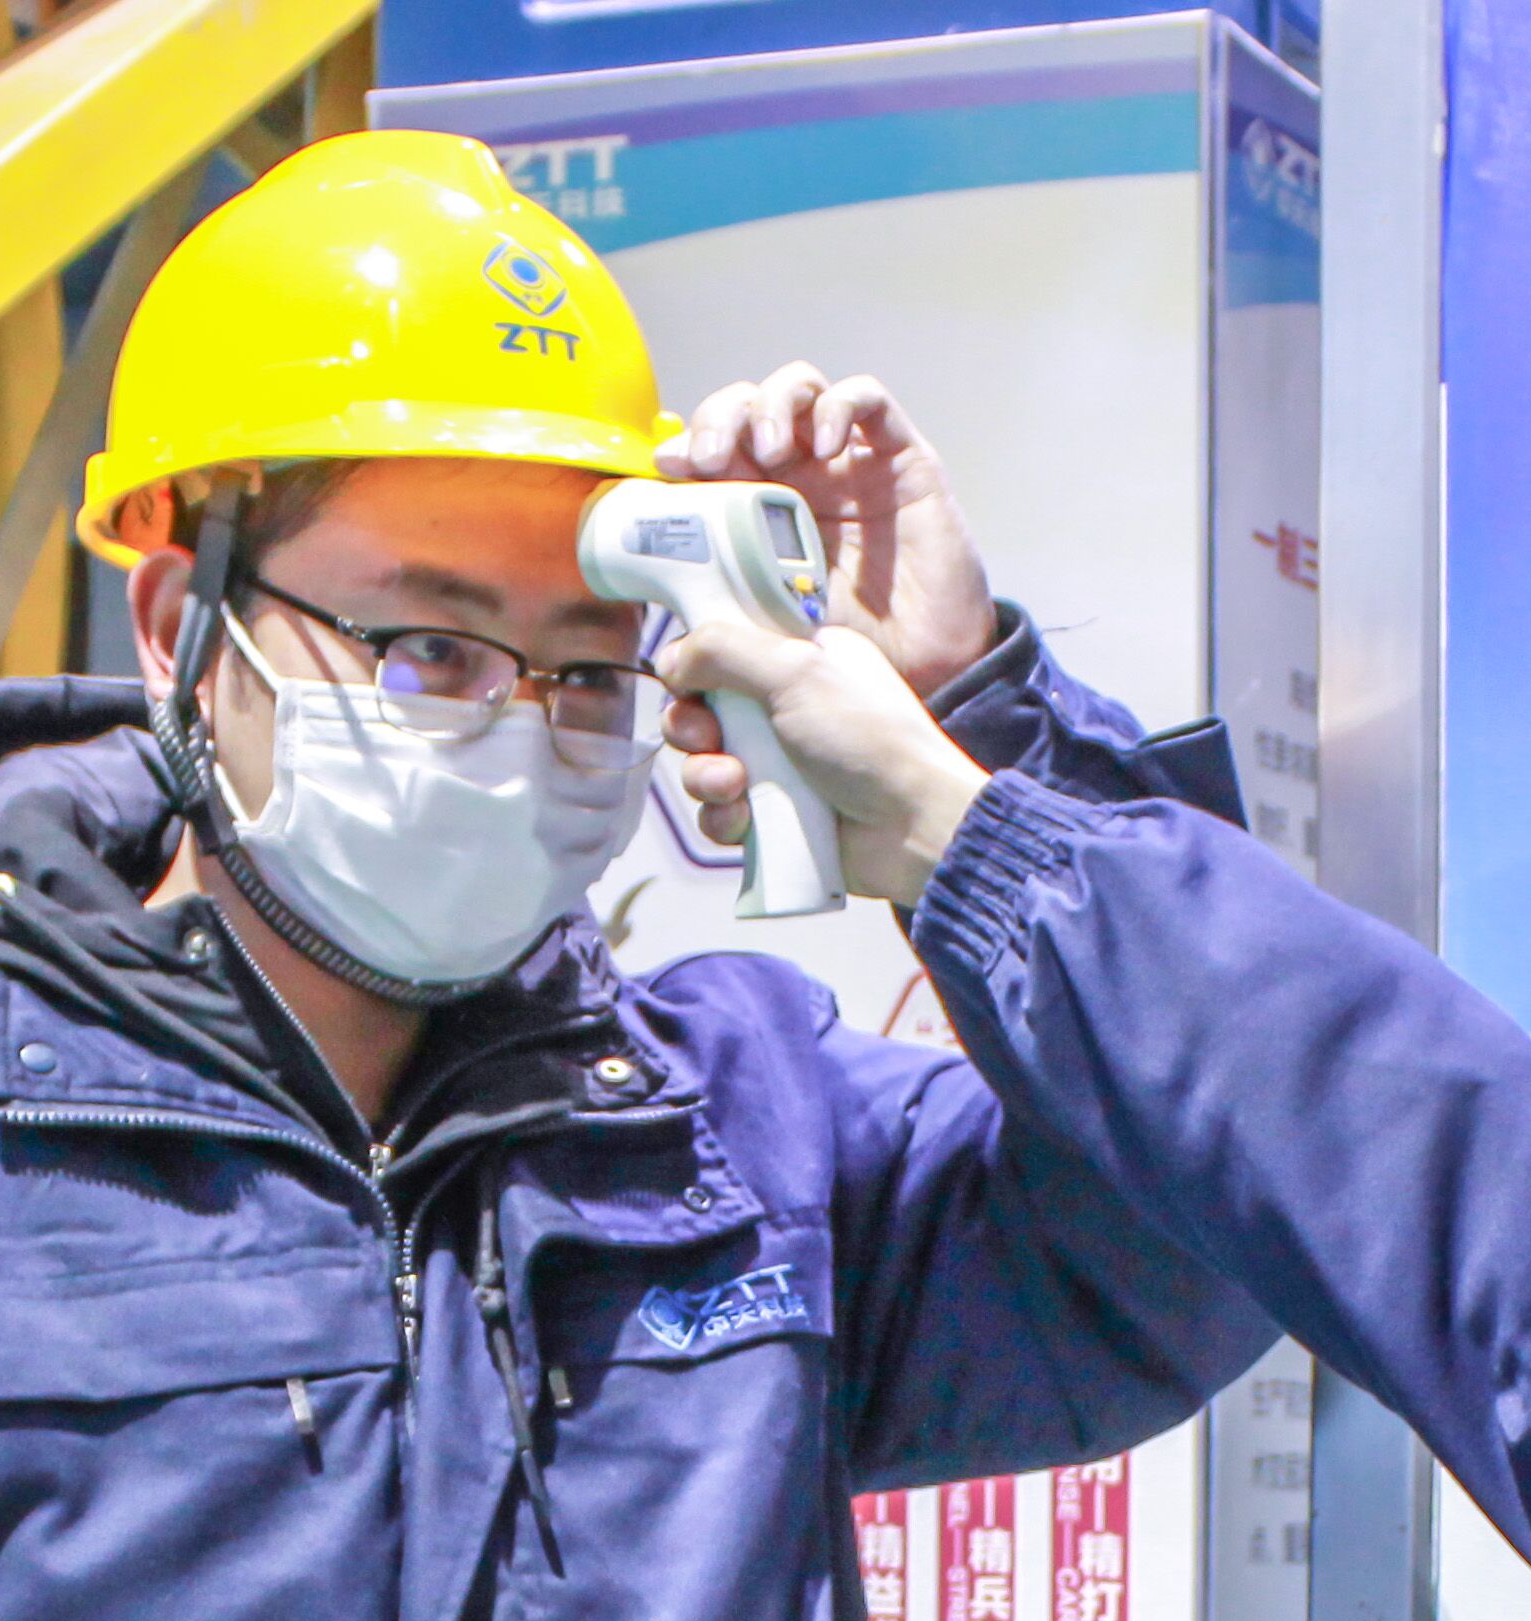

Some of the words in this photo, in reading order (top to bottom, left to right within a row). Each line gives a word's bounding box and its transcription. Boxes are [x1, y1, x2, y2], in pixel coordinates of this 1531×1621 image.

[500, 134, 628, 188] ZTT
[494, 321, 581, 362] ZTT
[678, 1263, 795, 1317] ZTT
